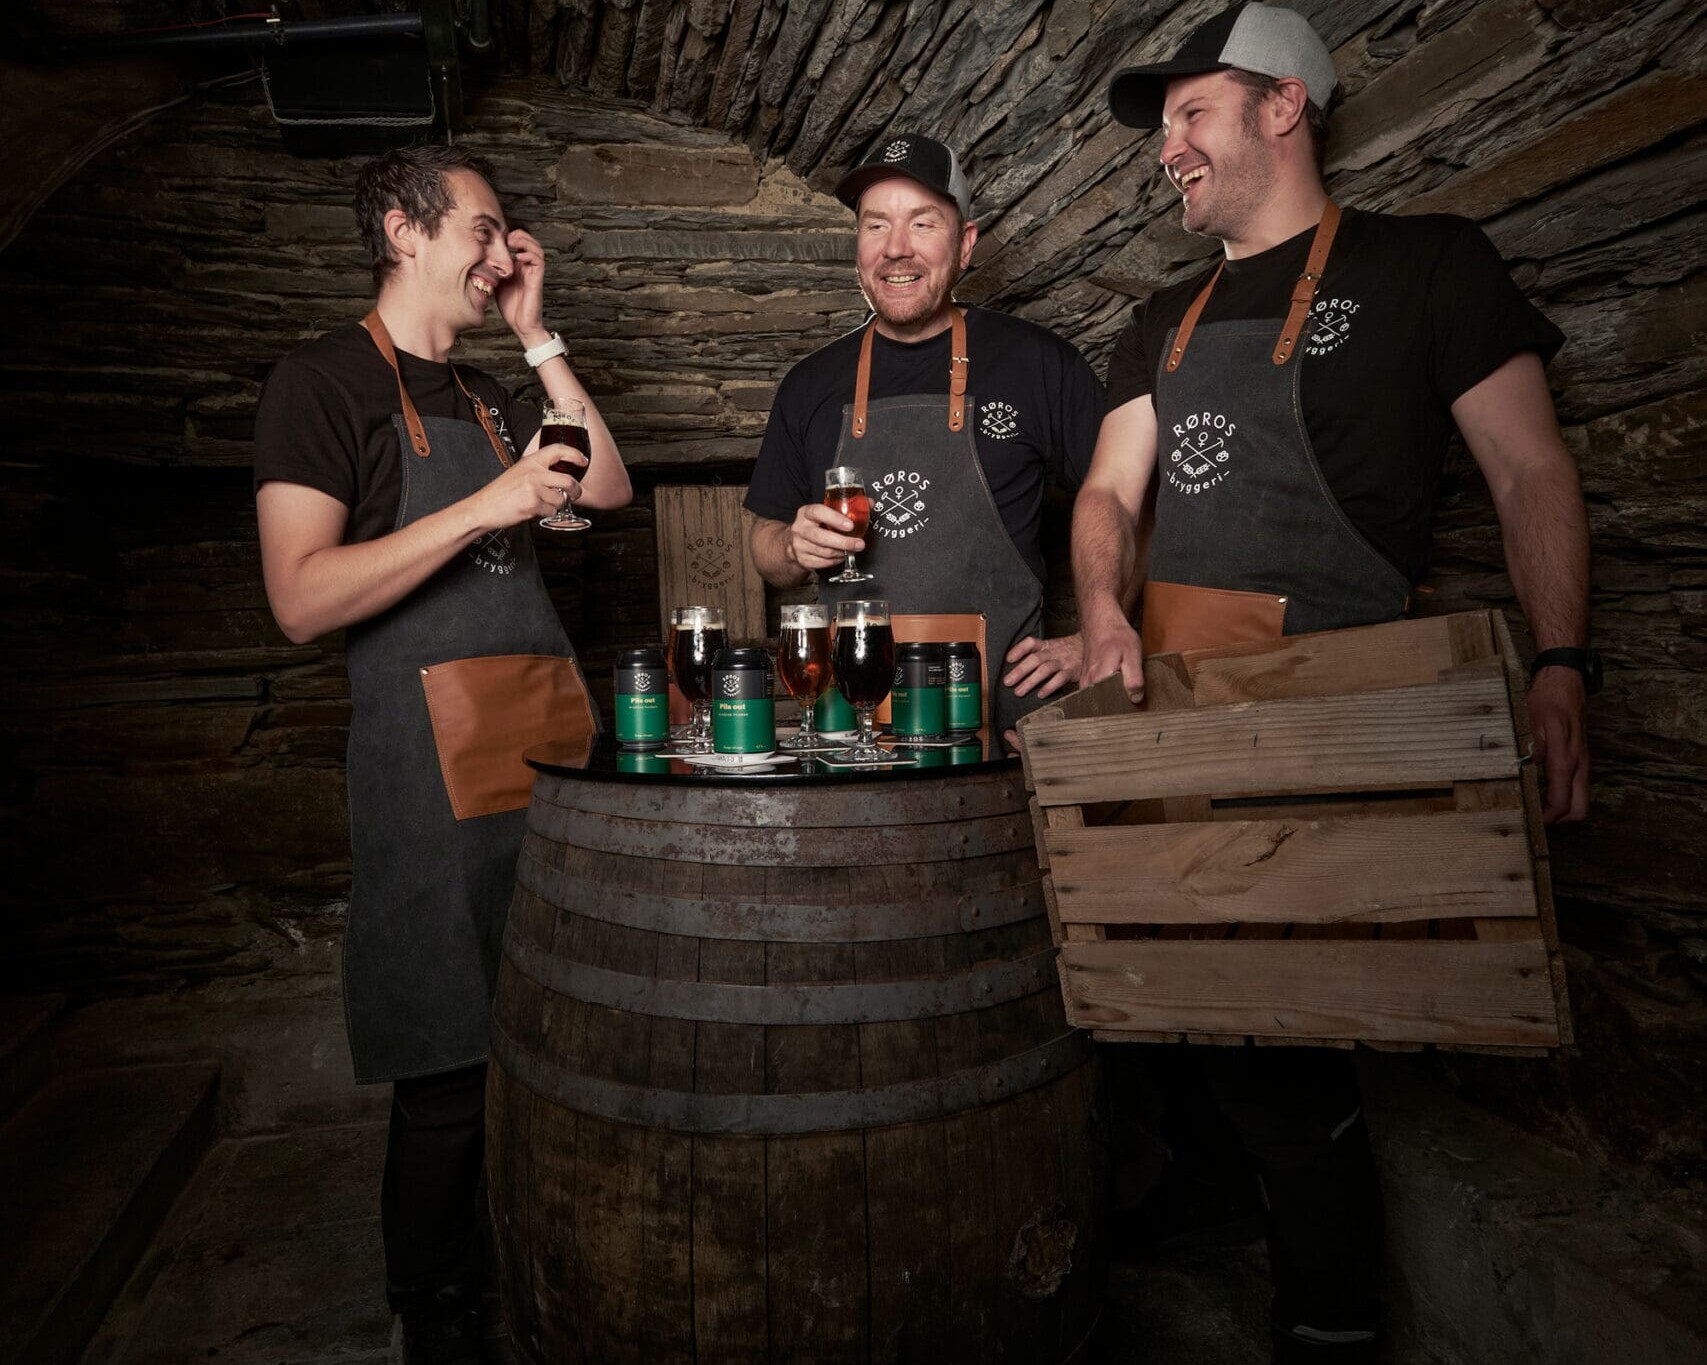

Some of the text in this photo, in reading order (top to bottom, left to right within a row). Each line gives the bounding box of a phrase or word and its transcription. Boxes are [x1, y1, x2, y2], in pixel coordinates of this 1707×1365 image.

[980, 401, 1019, 417] RØROS
[1172, 411, 1237, 438] RØROS
[871, 470, 930, 492] RØROS
[687, 536, 734, 553] RØROS
[719, 703, 746, 711] Pils out
